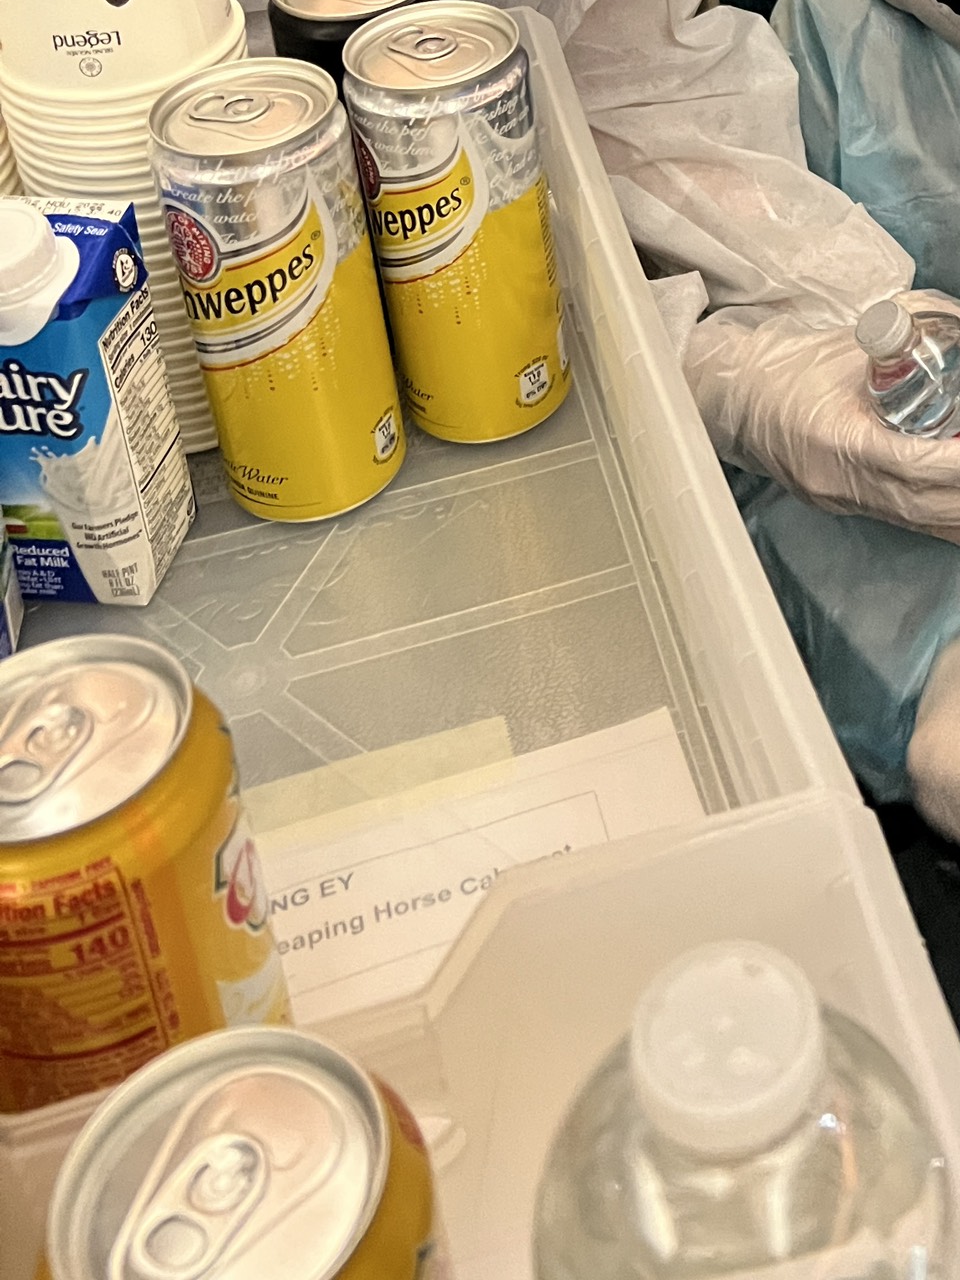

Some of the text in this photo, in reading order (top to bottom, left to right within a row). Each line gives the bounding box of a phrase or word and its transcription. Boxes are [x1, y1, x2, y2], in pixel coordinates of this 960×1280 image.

[52, 30, 122, 51] Legend
[171, 188, 213, 204] create
[215, 187, 243, 204] the
[53, 222, 108, 236] Safety Seal
[191, 227, 213, 265] MIXING
[102, 311, 131, 353] Nutrition
[130, 288, 149, 315] Facts
[140, 321, 158, 346] 130
[238, 465, 289, 485] Water
[84, 521, 114, 531] Farmers
[114, 511, 139, 526] Pledge
[98, 526, 129, 541] Artificial
[16, 555, 70, 568] Fat Milk
[121, 562, 139, 578] PINT
[53, 879, 117, 918] Facts
[269, 872, 355, 916] NG EY
[276, 912, 366, 956] eaping
[374, 886, 453, 924] Horse
[71, 923, 130, 967] 140
